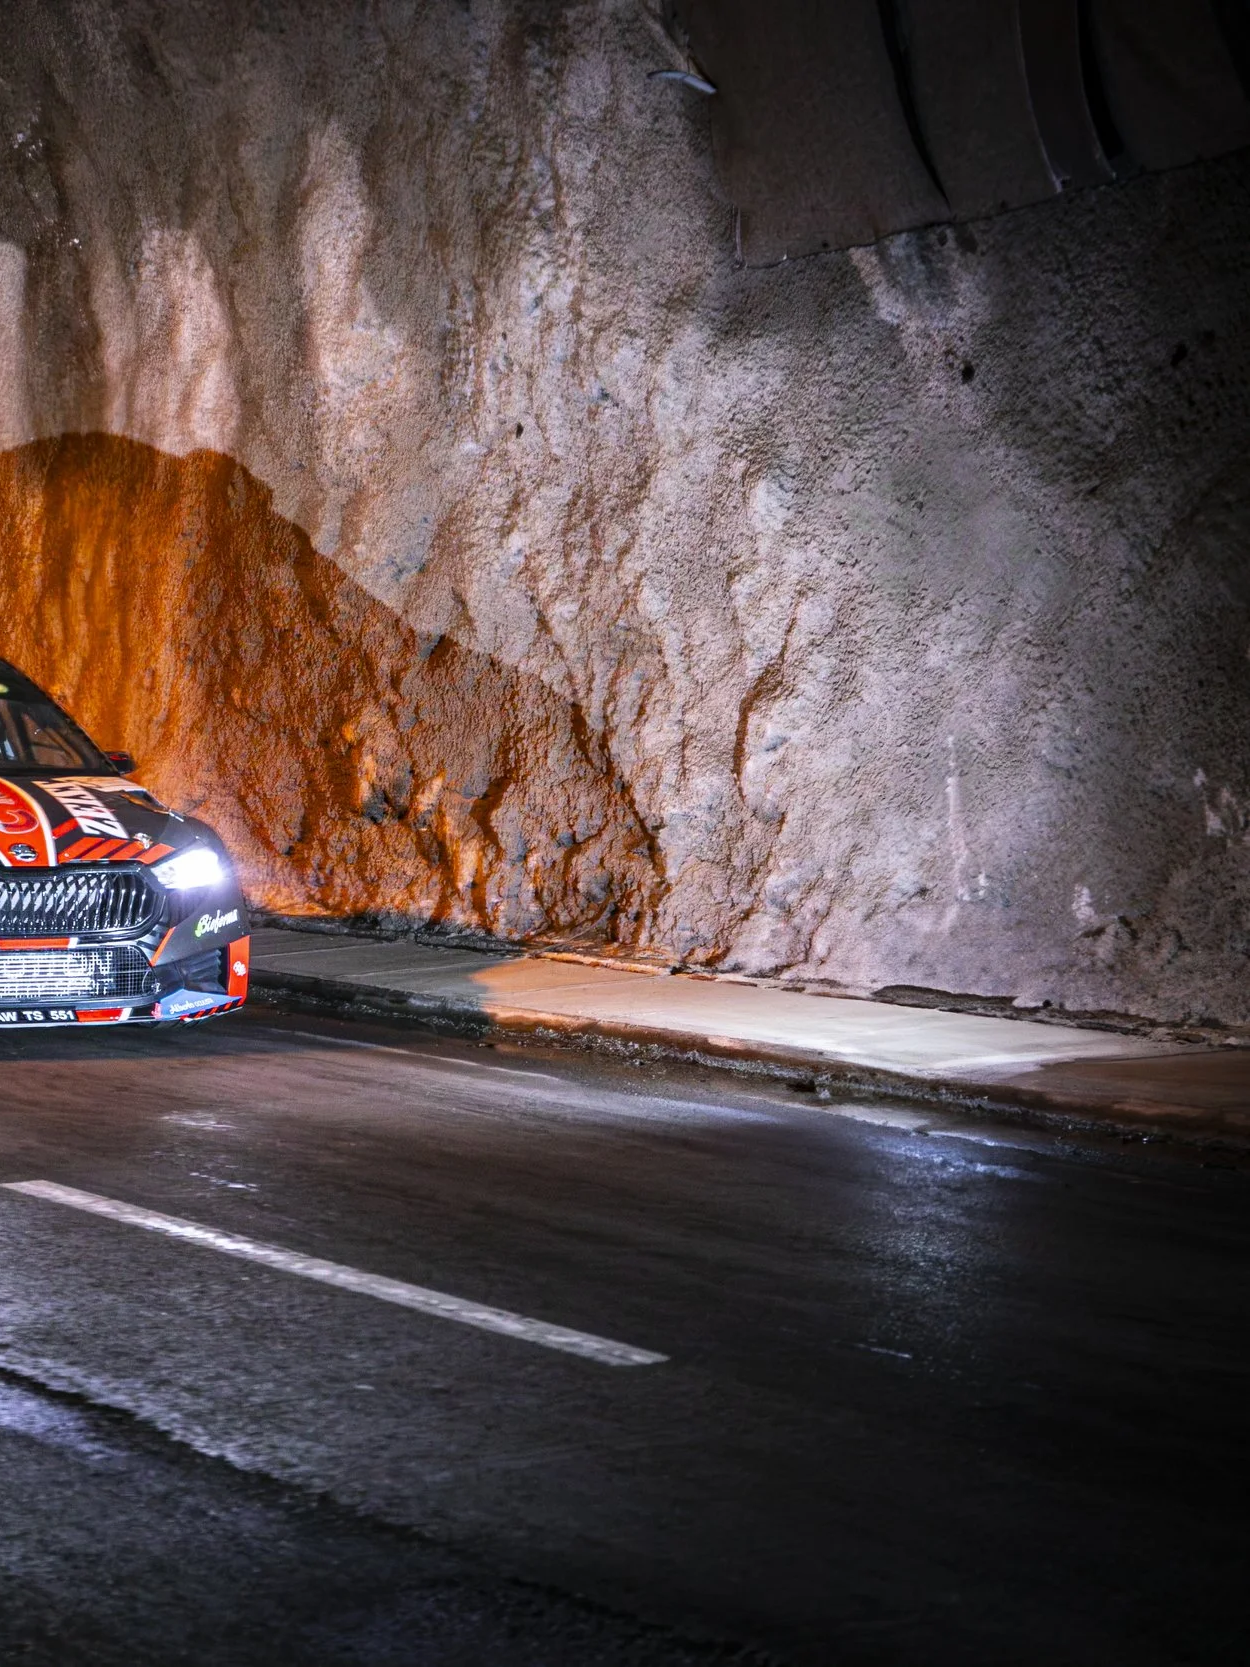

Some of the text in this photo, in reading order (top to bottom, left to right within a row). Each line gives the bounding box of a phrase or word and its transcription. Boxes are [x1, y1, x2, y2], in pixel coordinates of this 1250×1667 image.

[32, 780, 130, 839] ZEISS
[22, 1010, 44, 1022] TS
[50, 1009, 76, 1021] 551
